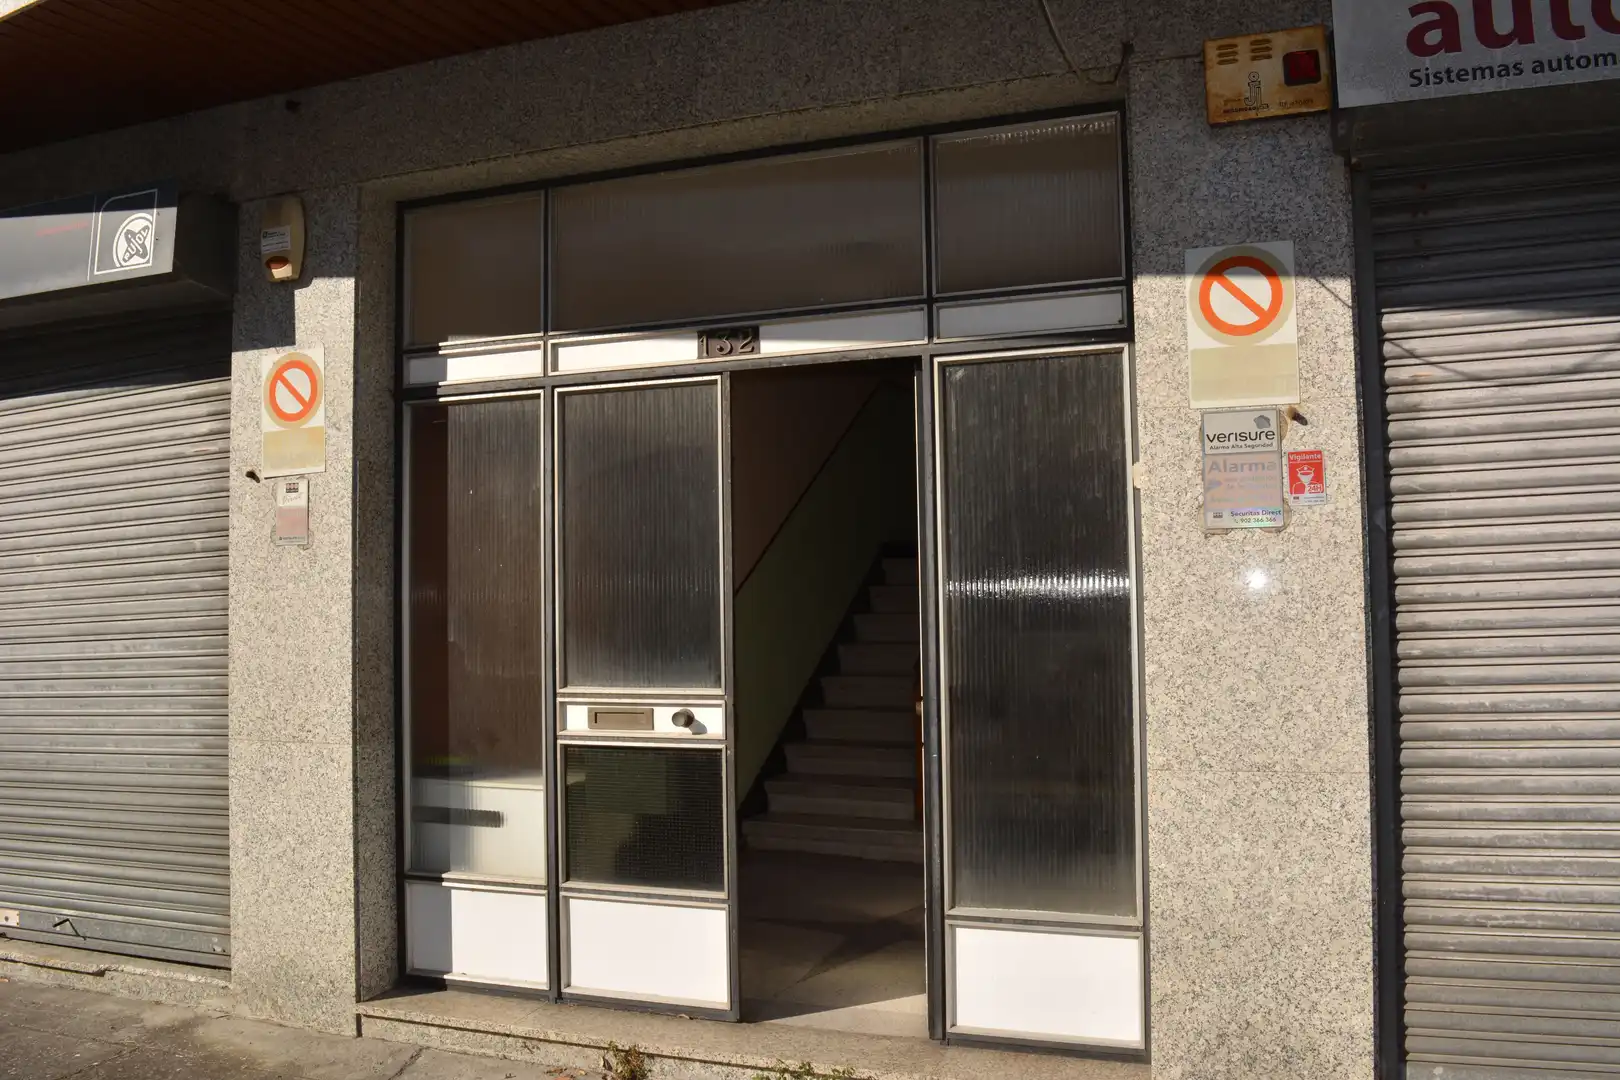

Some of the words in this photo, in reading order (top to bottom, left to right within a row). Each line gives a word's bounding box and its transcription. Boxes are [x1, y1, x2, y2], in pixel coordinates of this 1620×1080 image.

[1409, 60, 1525, 88] Sistemas
[699, 327, 755, 357] 132
[1206, 430, 1276, 443] verisure
[1289, 453, 1322, 462] Vigilante
[1208, 458, 1277, 474] Alarma
